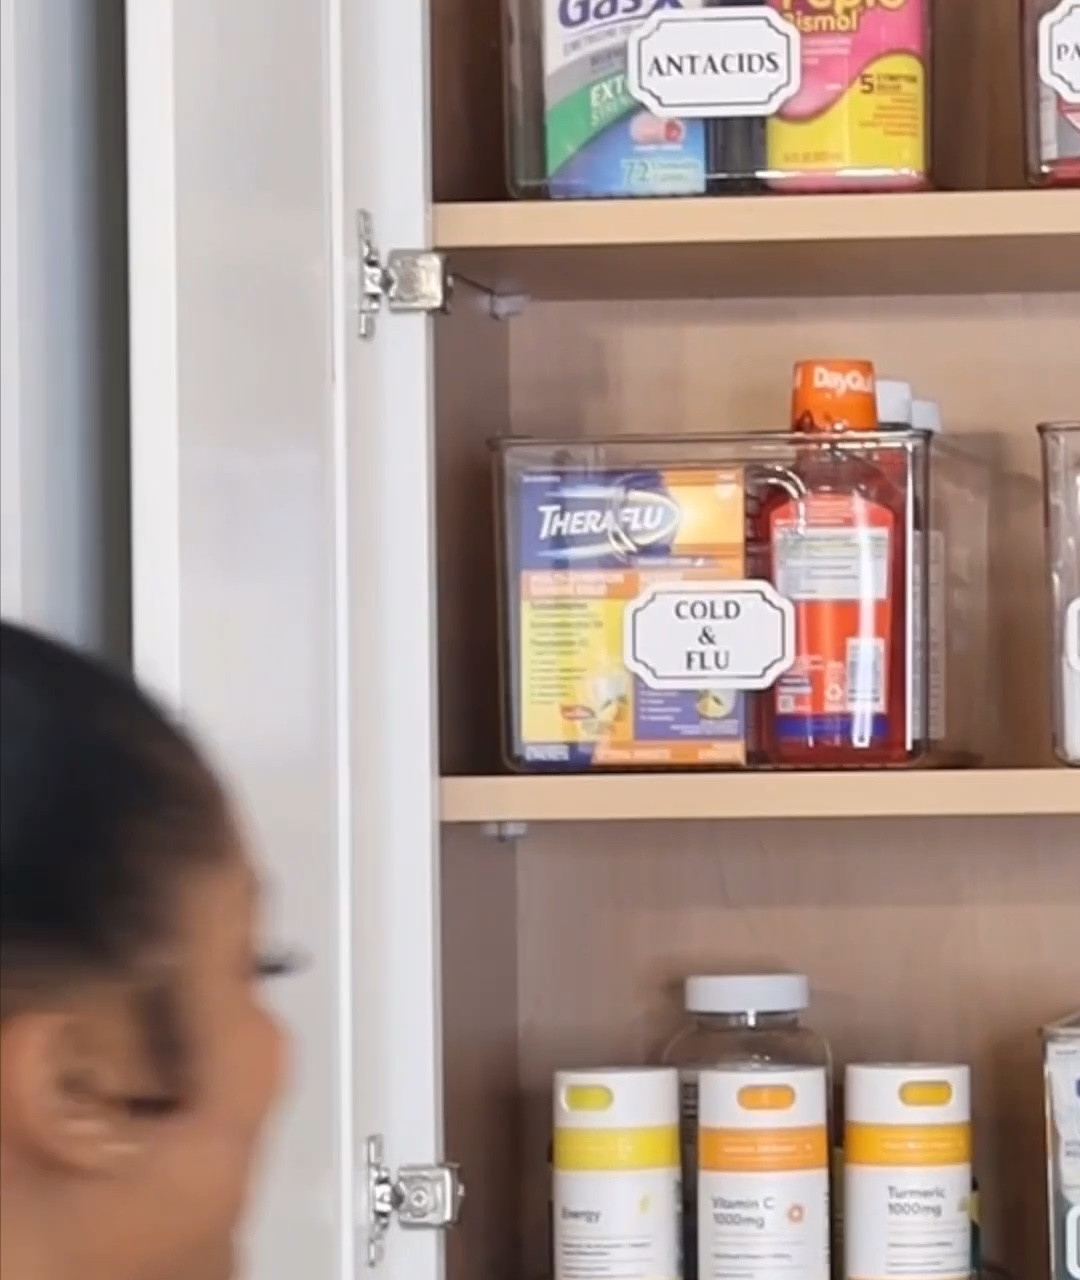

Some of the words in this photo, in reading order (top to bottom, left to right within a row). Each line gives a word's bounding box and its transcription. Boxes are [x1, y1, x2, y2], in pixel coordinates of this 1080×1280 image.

[647, 52, 781, 77] ANTACIDS
[590, 73, 628, 102] EXT
[859, 73, 875, 95] 5
[814, 366, 873, 397] DayQu
[537, 504, 664, 540] THERAFLU
[674, 599, 741, 620] COLD
[698, 626, 716, 646] &
[685, 651, 730, 670] FLU
[888, 1185, 946, 1199] Turmeric
[711, 1196, 759, 1210] Vitamin
[763, 1196, 776, 1209] C
[887, 1202, 942, 1218] 1000mg
[712, 1212, 765, 1229] 1000mg
